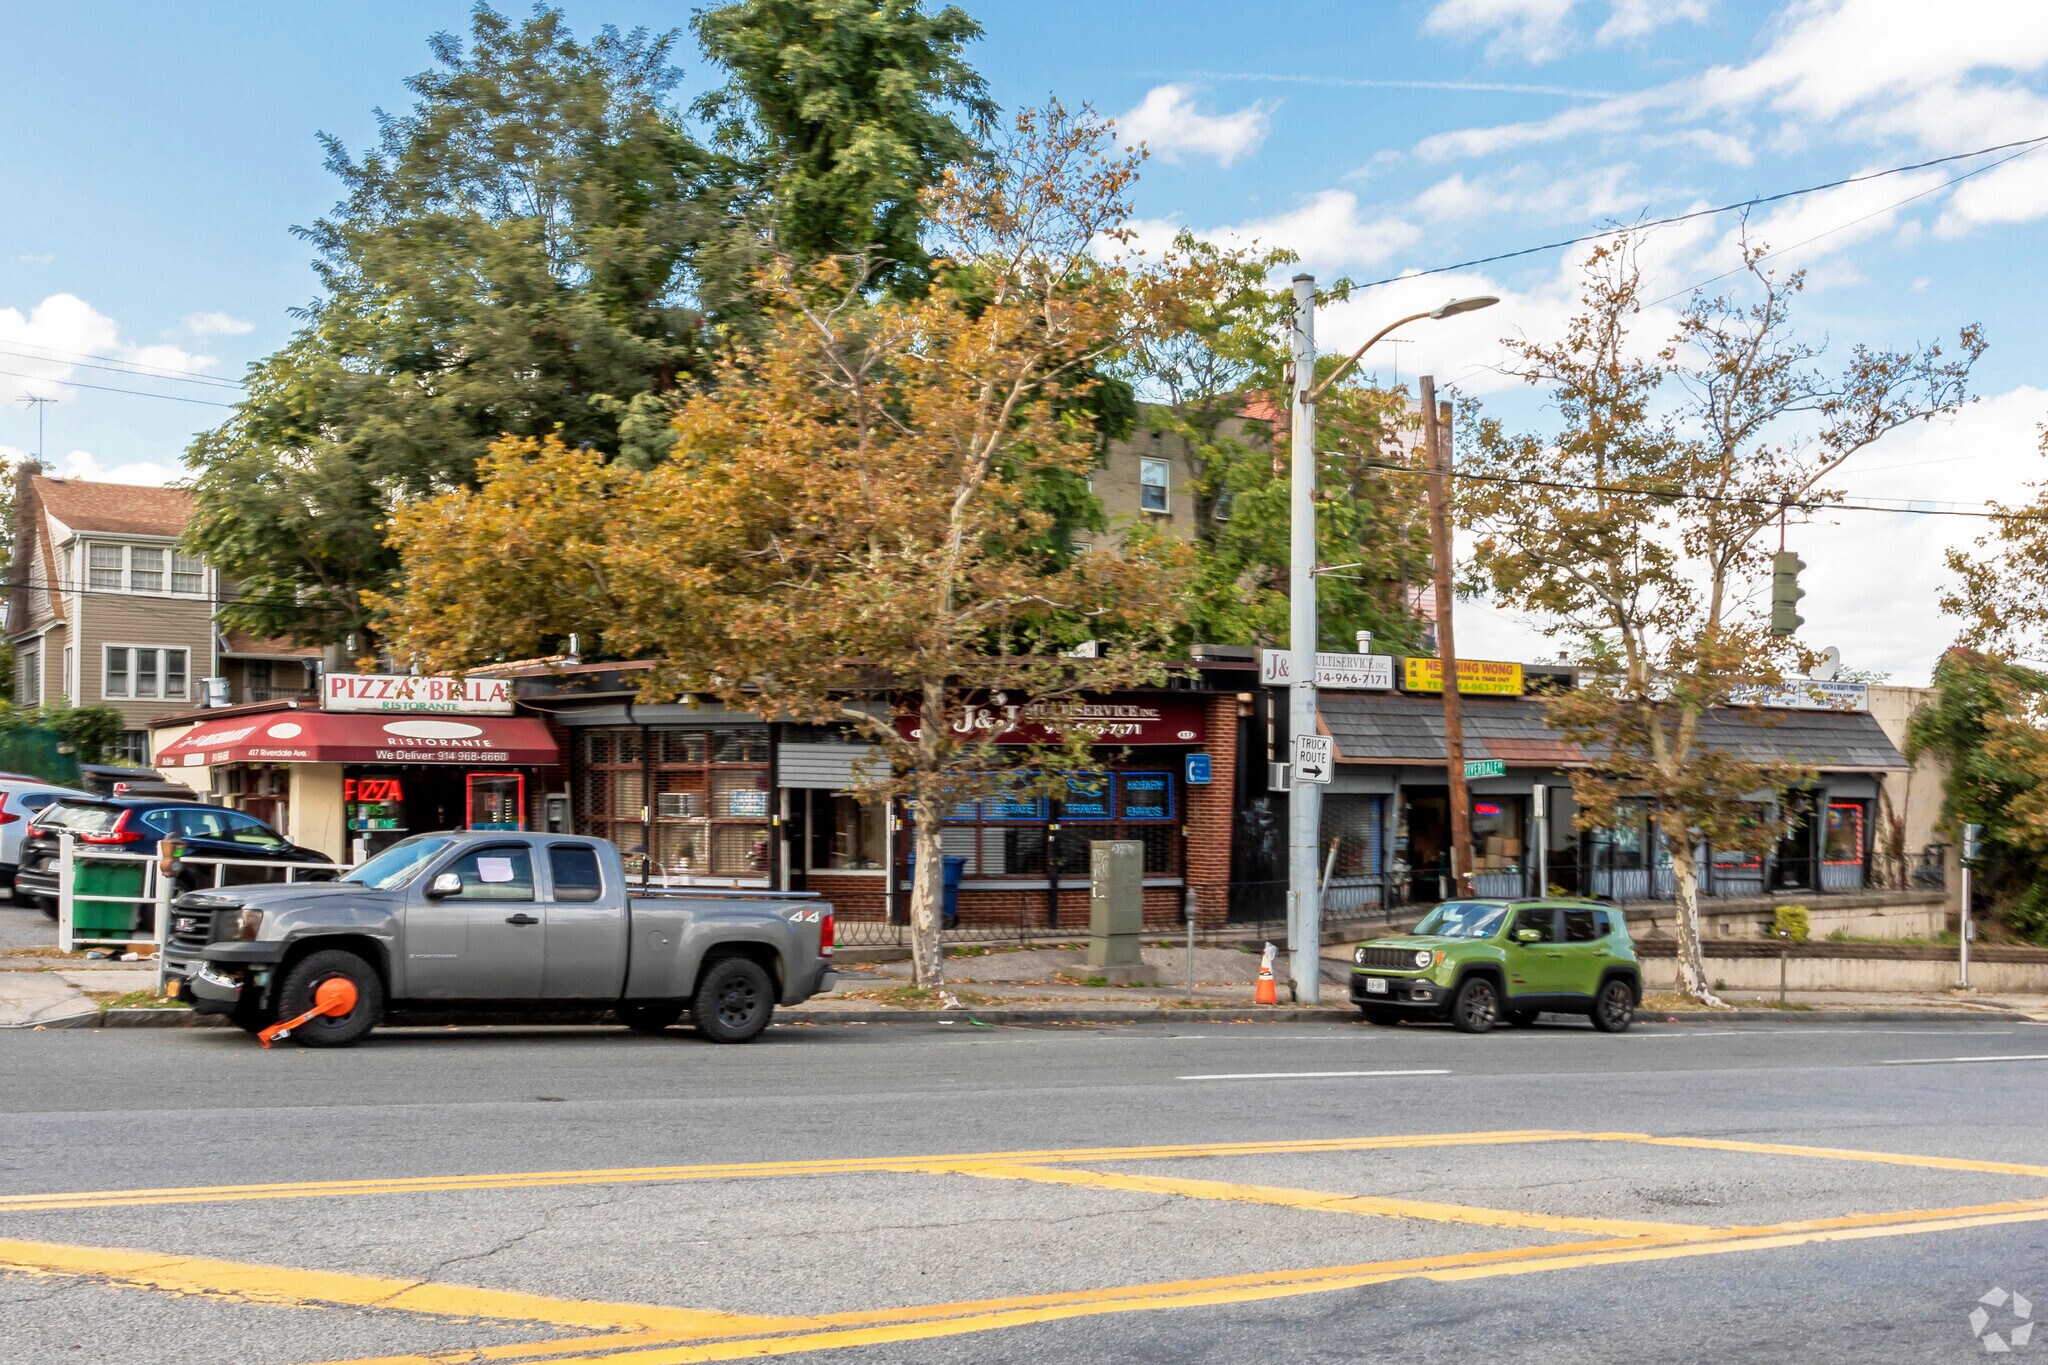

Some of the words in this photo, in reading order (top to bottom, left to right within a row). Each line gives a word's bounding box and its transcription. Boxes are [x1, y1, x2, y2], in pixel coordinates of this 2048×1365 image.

[1266, 654, 1290, 680] J&
[1315, 655, 1374, 669] ULTISERVICE
[1425, 660, 1444, 672] NE
[1482, 663, 1513, 675] WONG
[1317, 672, 1387, 685] 14-966-7171
[331, 677, 414, 700] PIZZA
[430, 681, 507, 702] BELLA
[382, 701, 459, 711] RISTORANTE
[387, 737, 492, 747] RISTORANTE
[1302, 738, 1327, 750] TRUCK
[260, 749, 292, 757] Riverdale
[376, 750, 394, 760] We
[438, 751, 455, 761] 914
[458, 751, 508, 761] 968-6660
[1300, 751, 1326, 763] ROUTE
[1464, 761, 1498, 776] RIVERDALE
